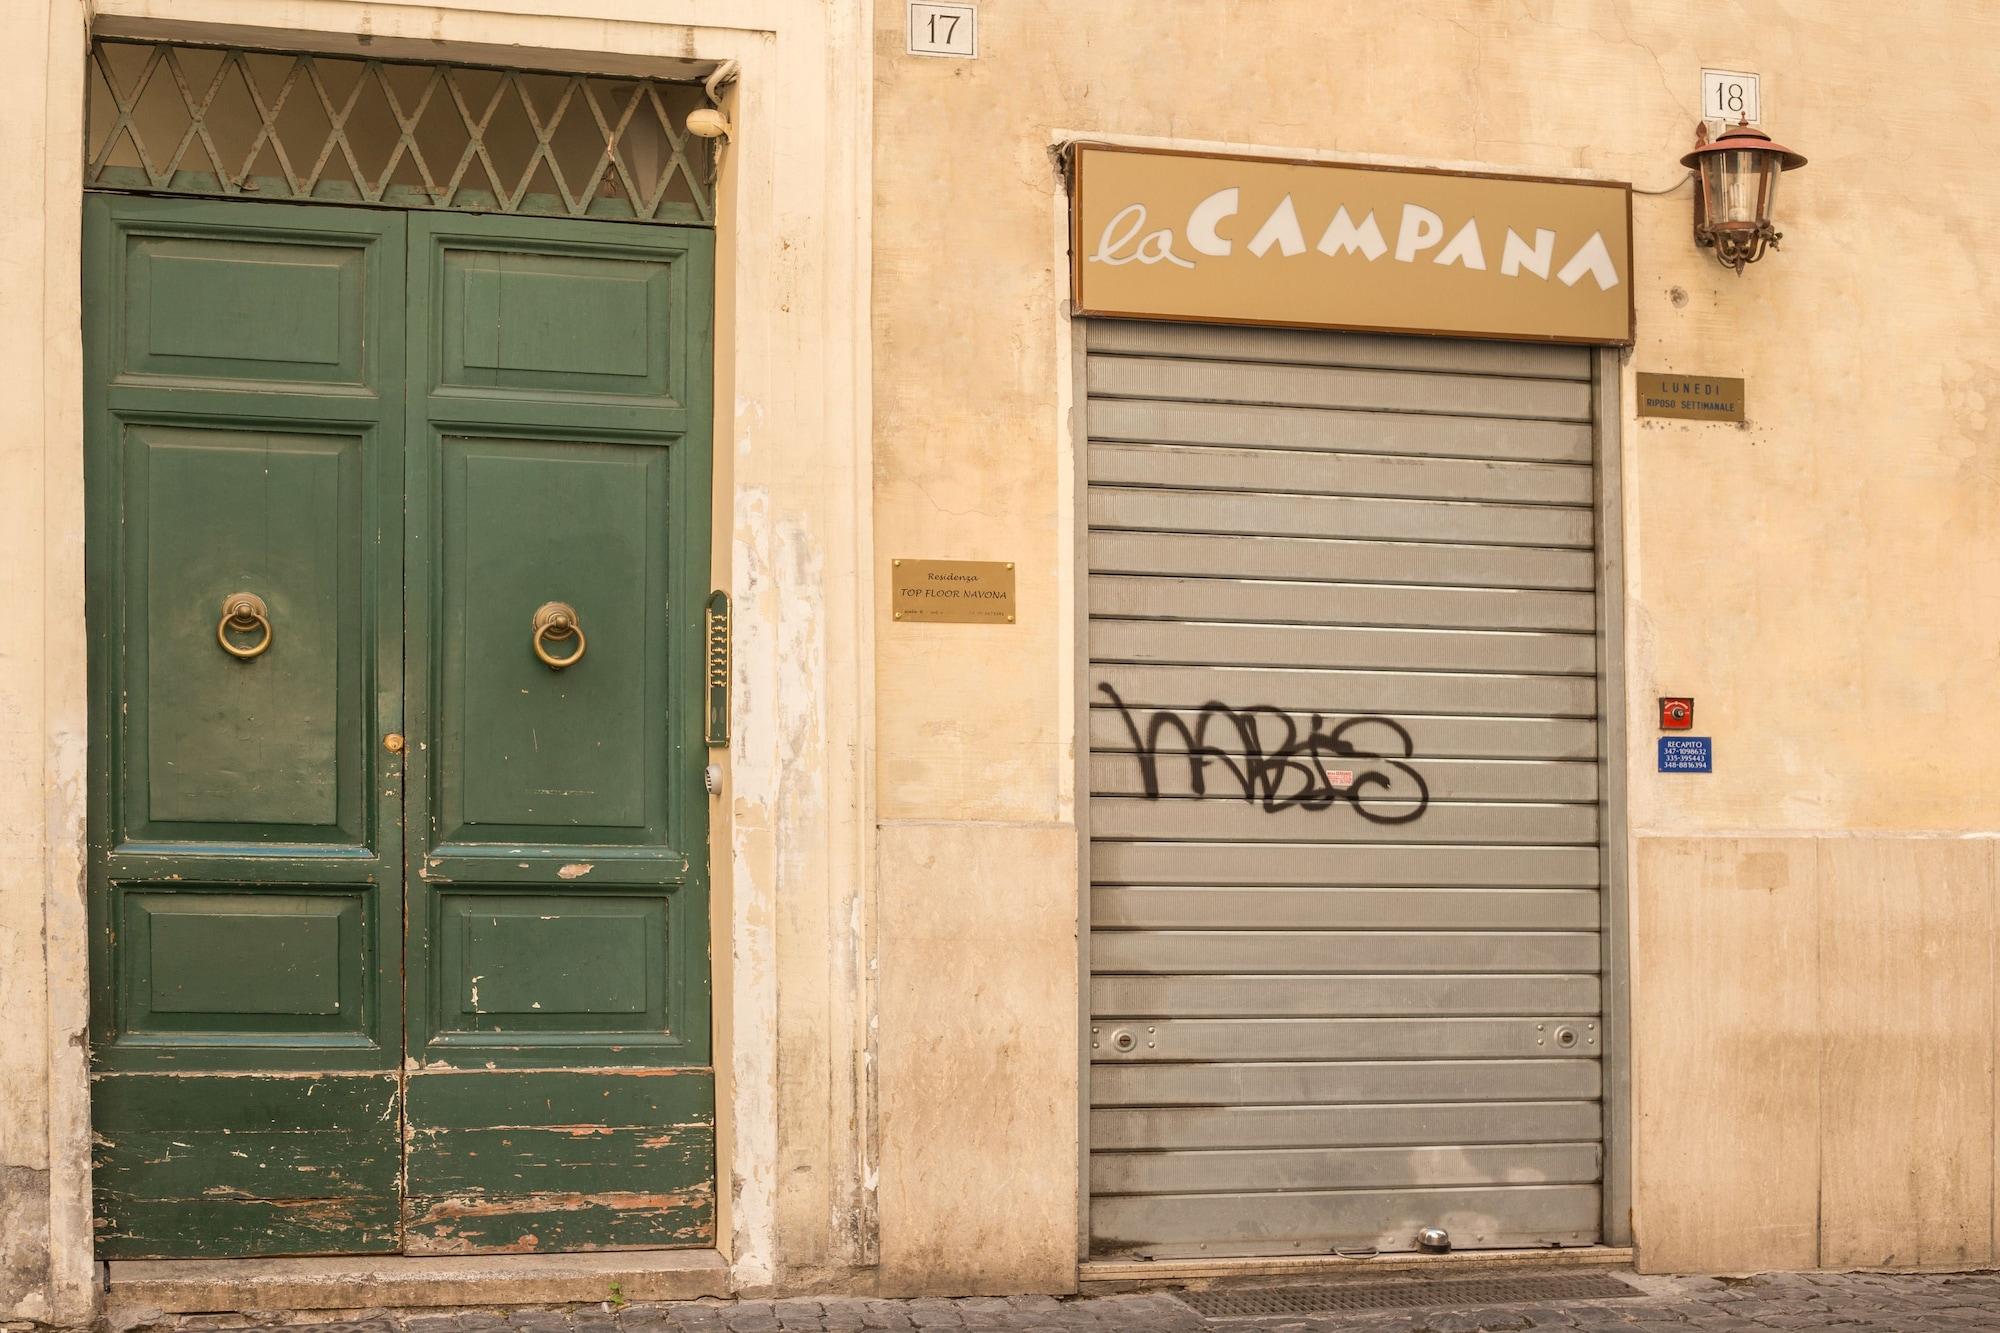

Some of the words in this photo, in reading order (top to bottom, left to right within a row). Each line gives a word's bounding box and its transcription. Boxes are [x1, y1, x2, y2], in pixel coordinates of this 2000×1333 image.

[927, 13, 961, 44] 17
[1716, 82, 1743, 111] 18
[1088, 202, 1196, 270] la
[1186, 186, 1620, 292] CAMPANA
[1662, 382, 1720, 395] LUNEDI
[1646, 398, 1676, 408] RIPOSO
[1681, 400, 1735, 412] SETTIMANALE
[928, 572, 978, 583] Residenza
[900, 588, 922, 598] TOP
[925, 588, 960, 599] FLOOR
[963, 589, 1007, 600] NAVONA
